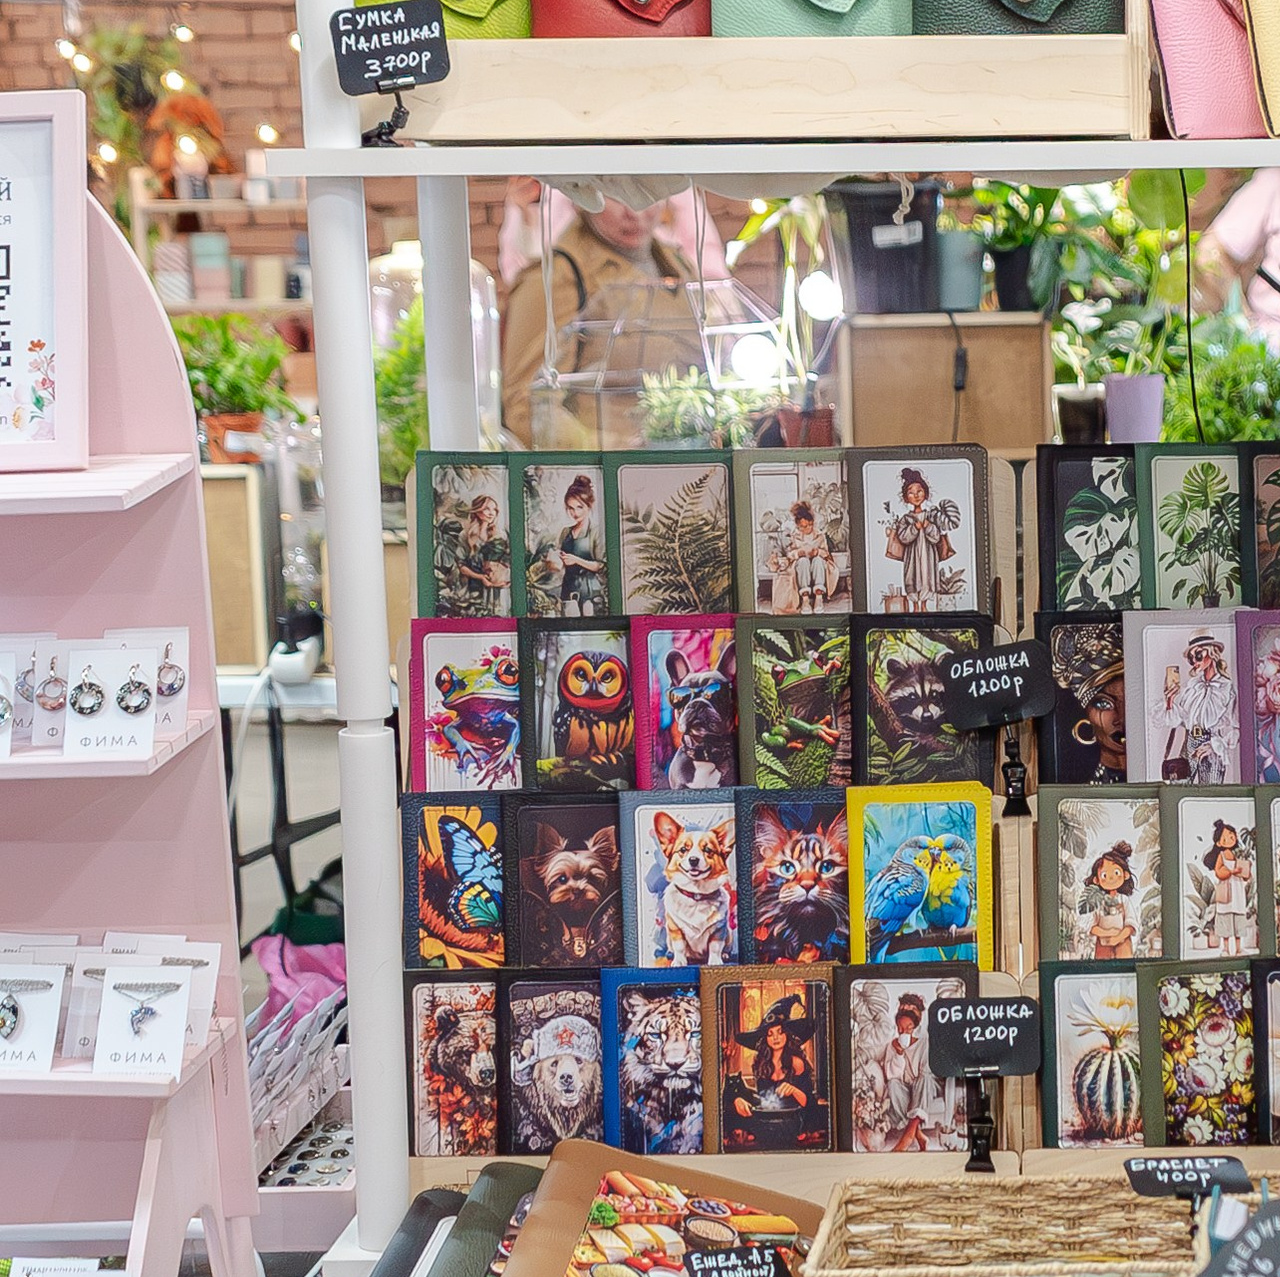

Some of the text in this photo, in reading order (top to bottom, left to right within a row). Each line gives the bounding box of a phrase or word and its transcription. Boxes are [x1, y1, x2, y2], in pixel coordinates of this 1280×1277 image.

[338, 7, 405, 31] СУМКА
[341, 21, 440, 55] МАЛЕНЬКАЯ
[950, 651, 1030, 679] ОБЛОЖКА
[80, 735, 138, 747] ФИМА
[937, 1003, 1033, 1024] ОБЛОЖКА
[110, 1052, 166, 1063] ФИМА
[1130, 1158, 1228, 1172] БРАСЛЕТ
